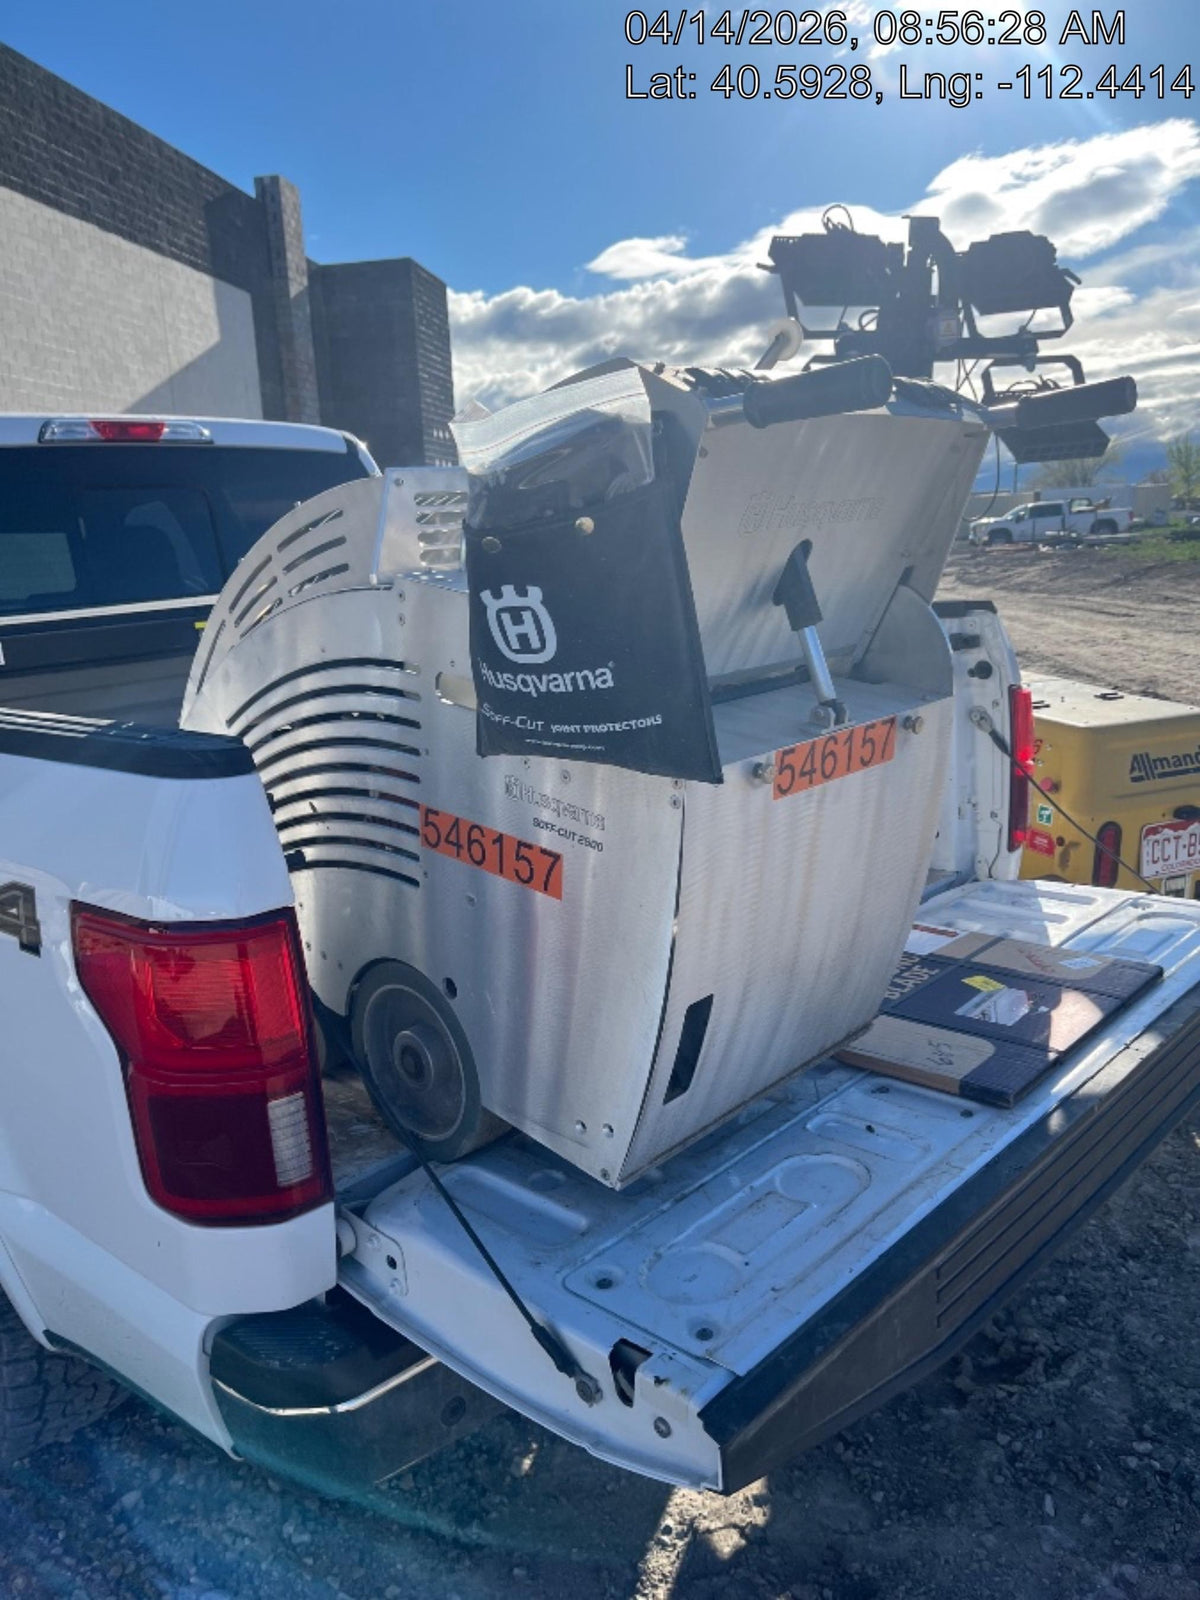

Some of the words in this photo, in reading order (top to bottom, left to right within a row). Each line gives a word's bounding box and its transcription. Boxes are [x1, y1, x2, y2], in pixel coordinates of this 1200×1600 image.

[479, 661, 615, 698] Husqvarna
[776, 715, 897, 796] 546157
[423, 807, 562, 892] 546157
